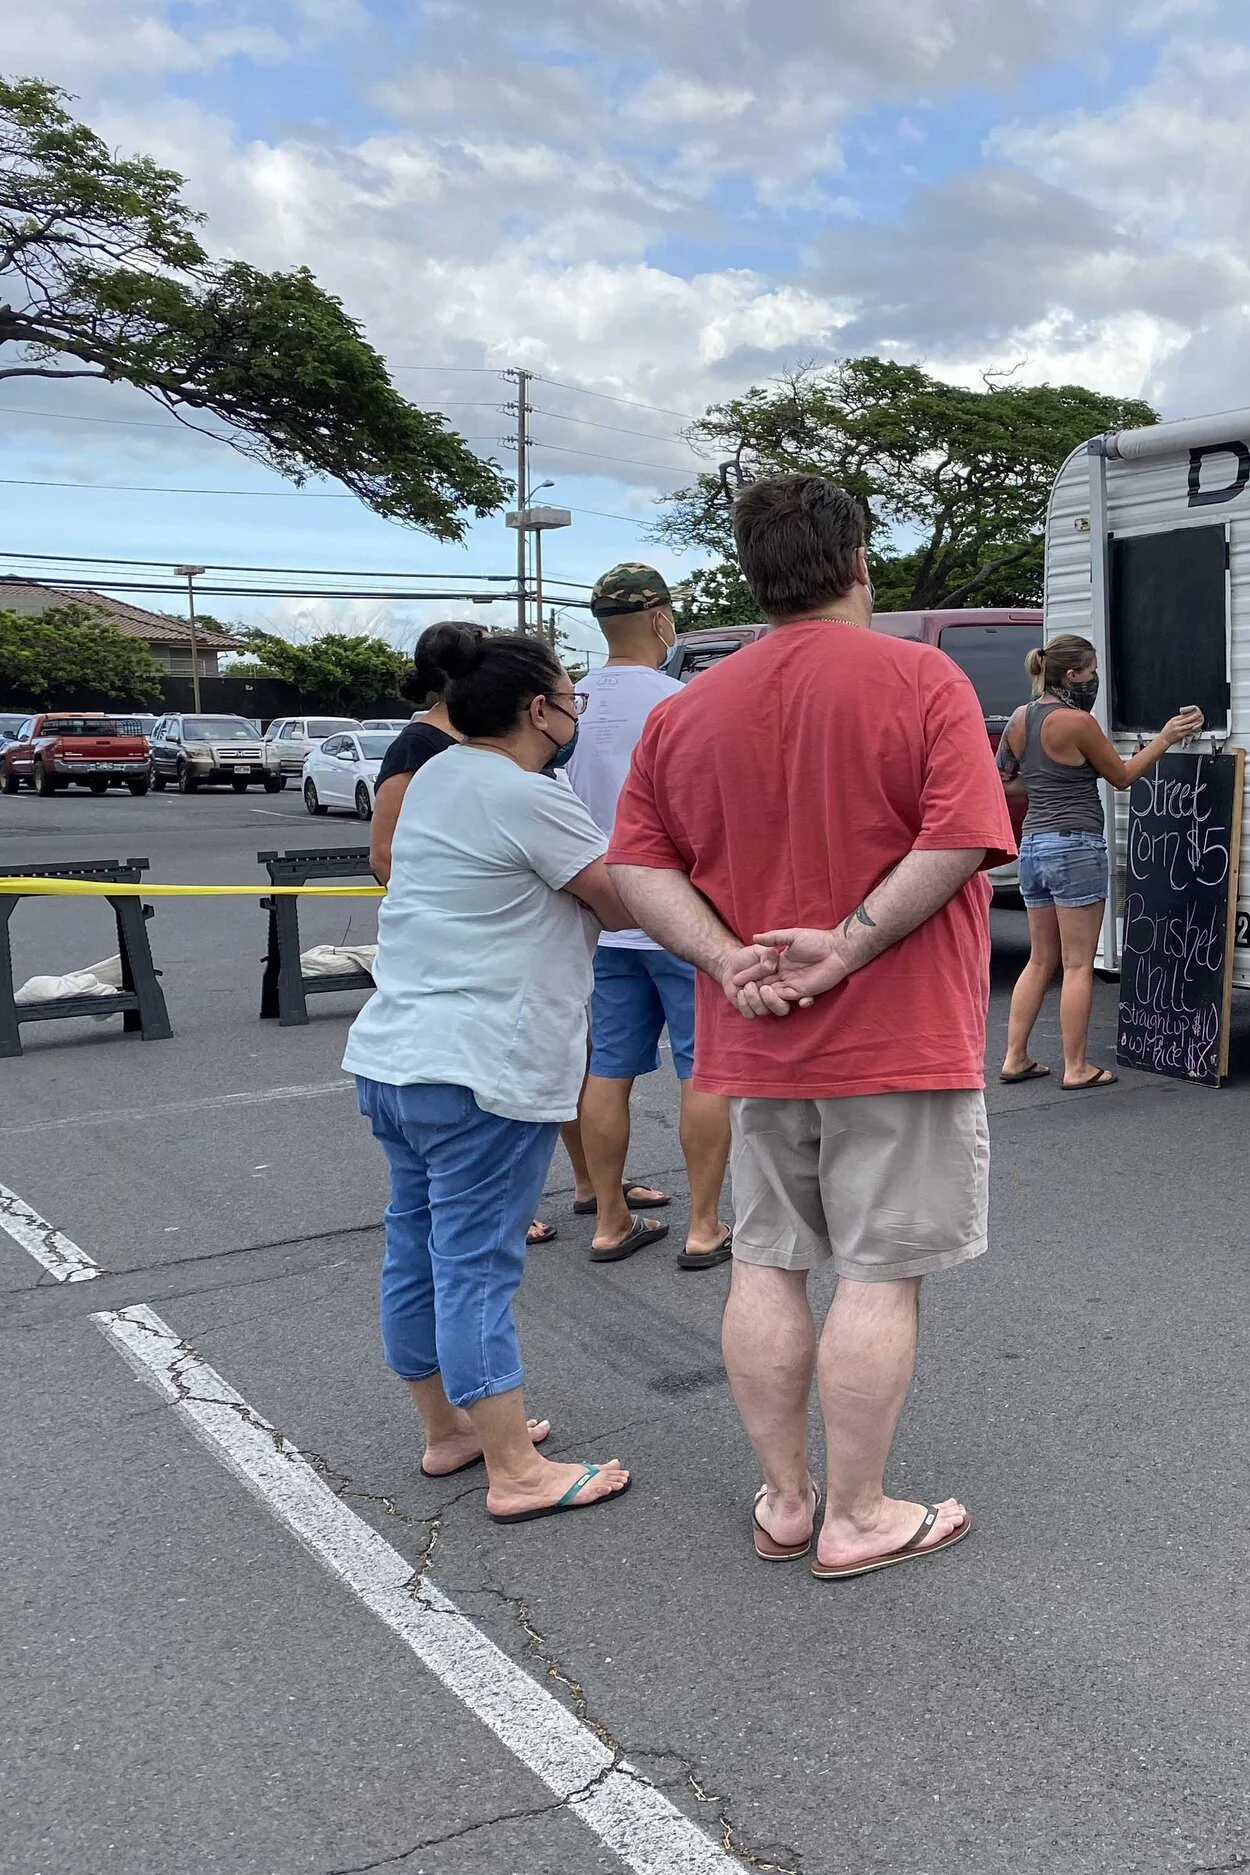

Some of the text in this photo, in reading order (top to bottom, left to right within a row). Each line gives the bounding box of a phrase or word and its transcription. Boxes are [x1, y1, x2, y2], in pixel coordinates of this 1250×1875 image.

[1131, 755, 1212, 821] Street
[1131, 818, 1188, 890] Corn
[1124, 892, 1223, 981] Brisket
[1136, 954, 1196, 1012] Chili
